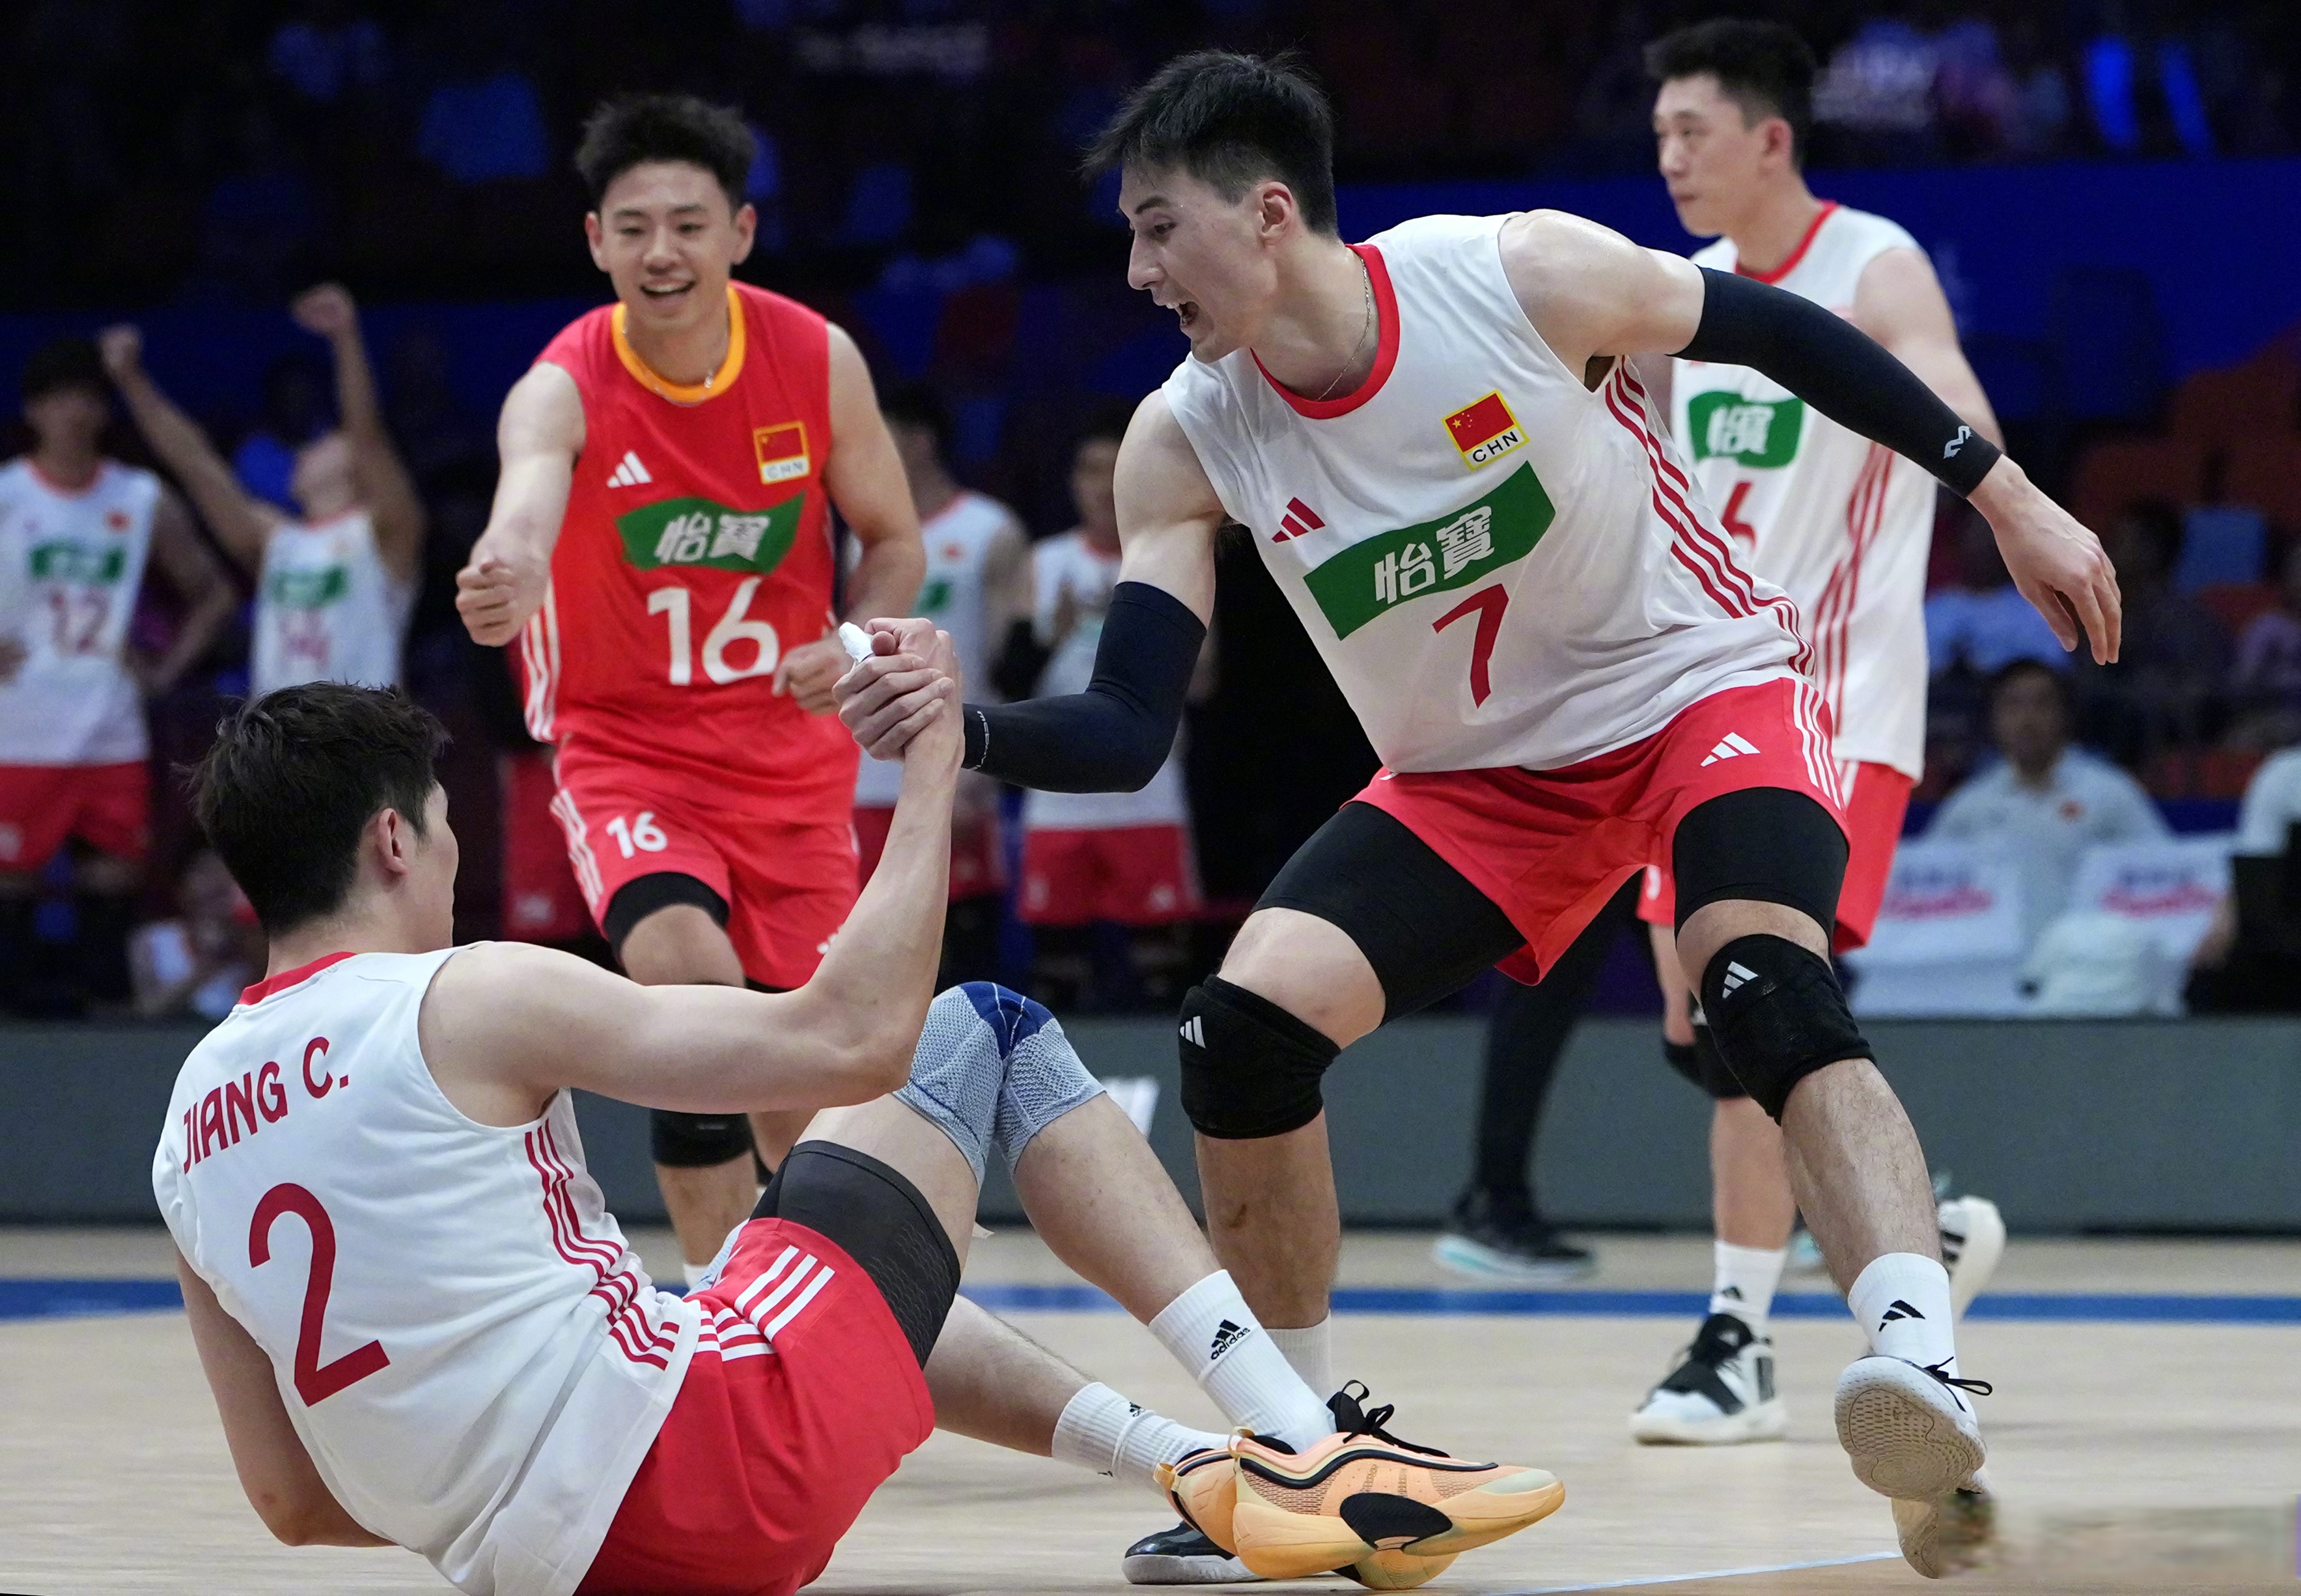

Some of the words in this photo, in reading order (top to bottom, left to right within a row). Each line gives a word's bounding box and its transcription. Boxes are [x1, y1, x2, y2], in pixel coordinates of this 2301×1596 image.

[766, 461, 804, 479] CHN
[1473, 431, 1518, 462] CHN
[1374, 506, 1495, 604] 怡寶
[648, 576, 780, 686] 16
[1432, 583, 1509, 709] 7
[606, 810, 668, 860] 16
[184, 1061, 288, 1175] JIANG
[303, 1037, 349, 1099] C.
[249, 1183, 391, 1407] 2
[1210, 1327, 1250, 1360] adidas
